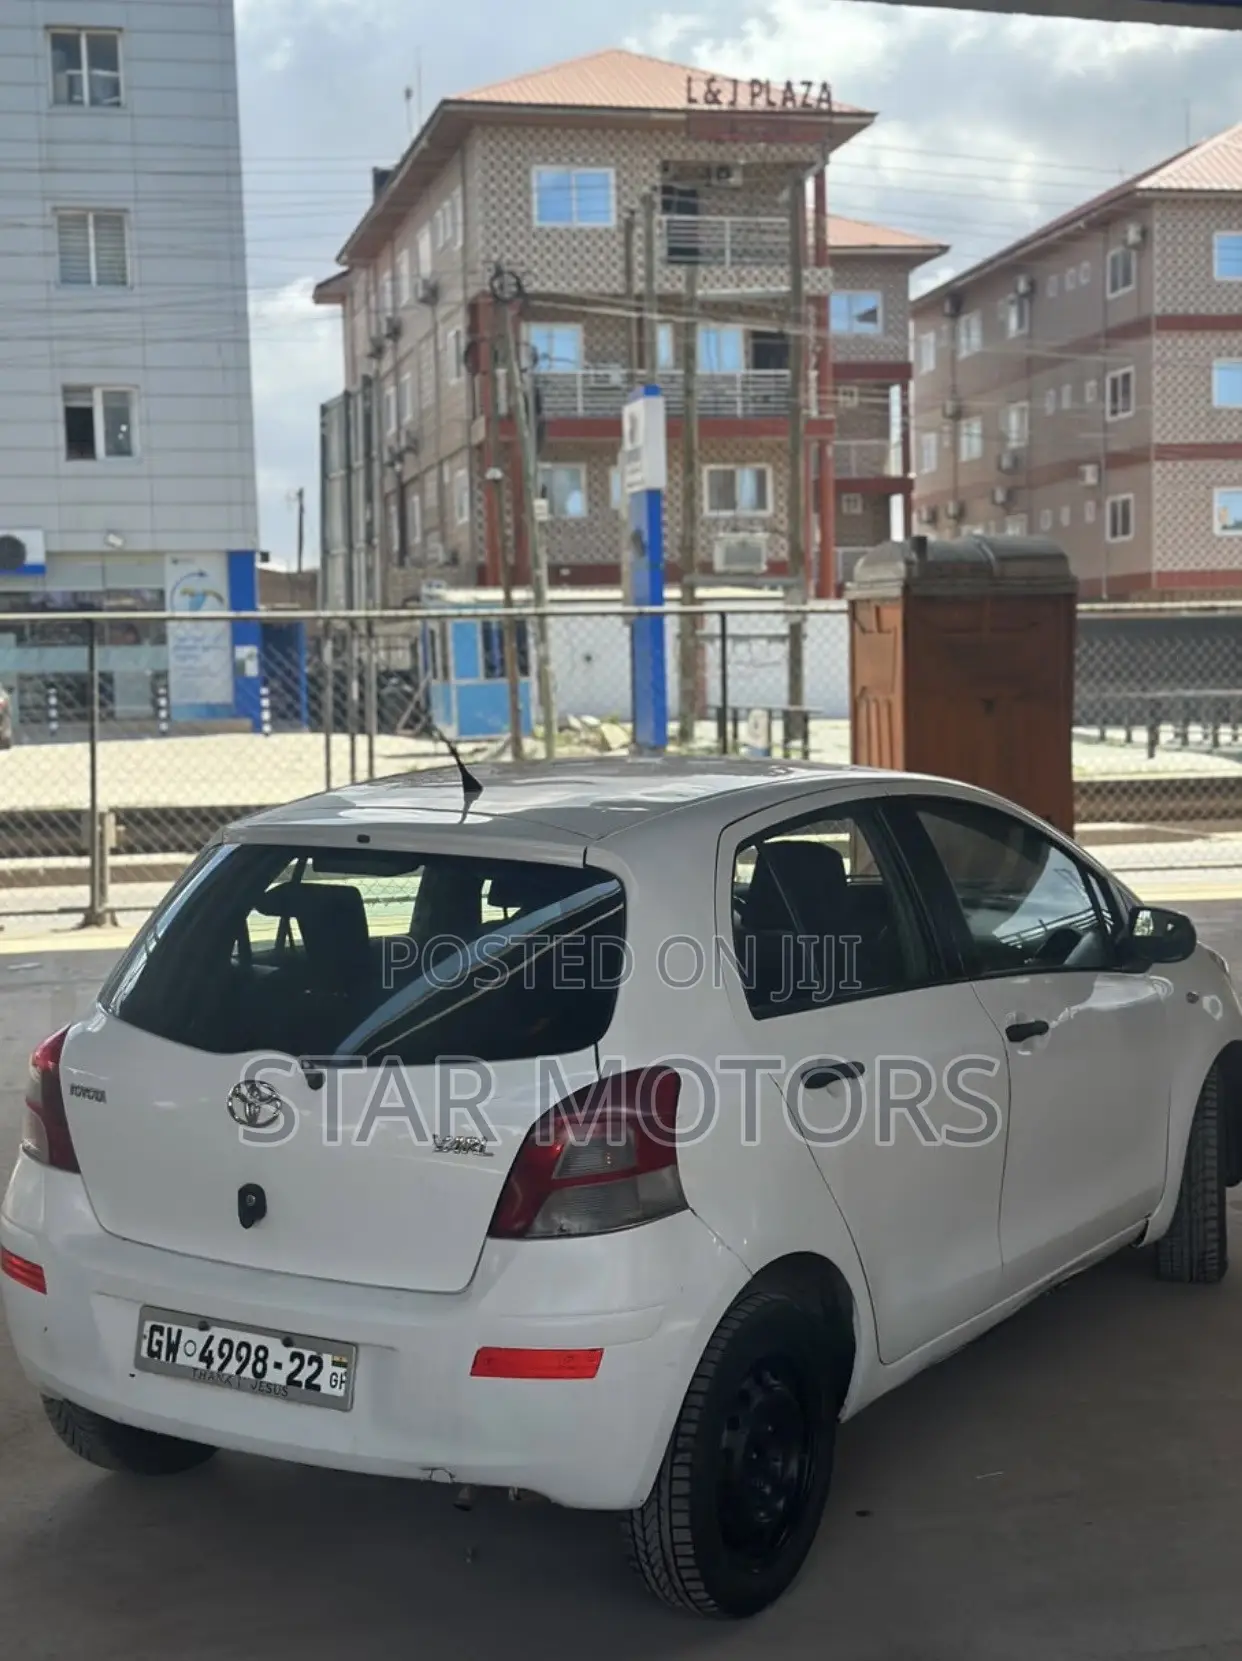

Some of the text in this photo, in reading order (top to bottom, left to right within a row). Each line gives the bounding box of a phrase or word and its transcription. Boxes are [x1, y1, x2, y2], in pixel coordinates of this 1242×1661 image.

[749, 79, 832, 111] PLAZA
[147, 1324, 324, 1392] GW 4998-22
[251, 1380, 288, 1397] JESUS
